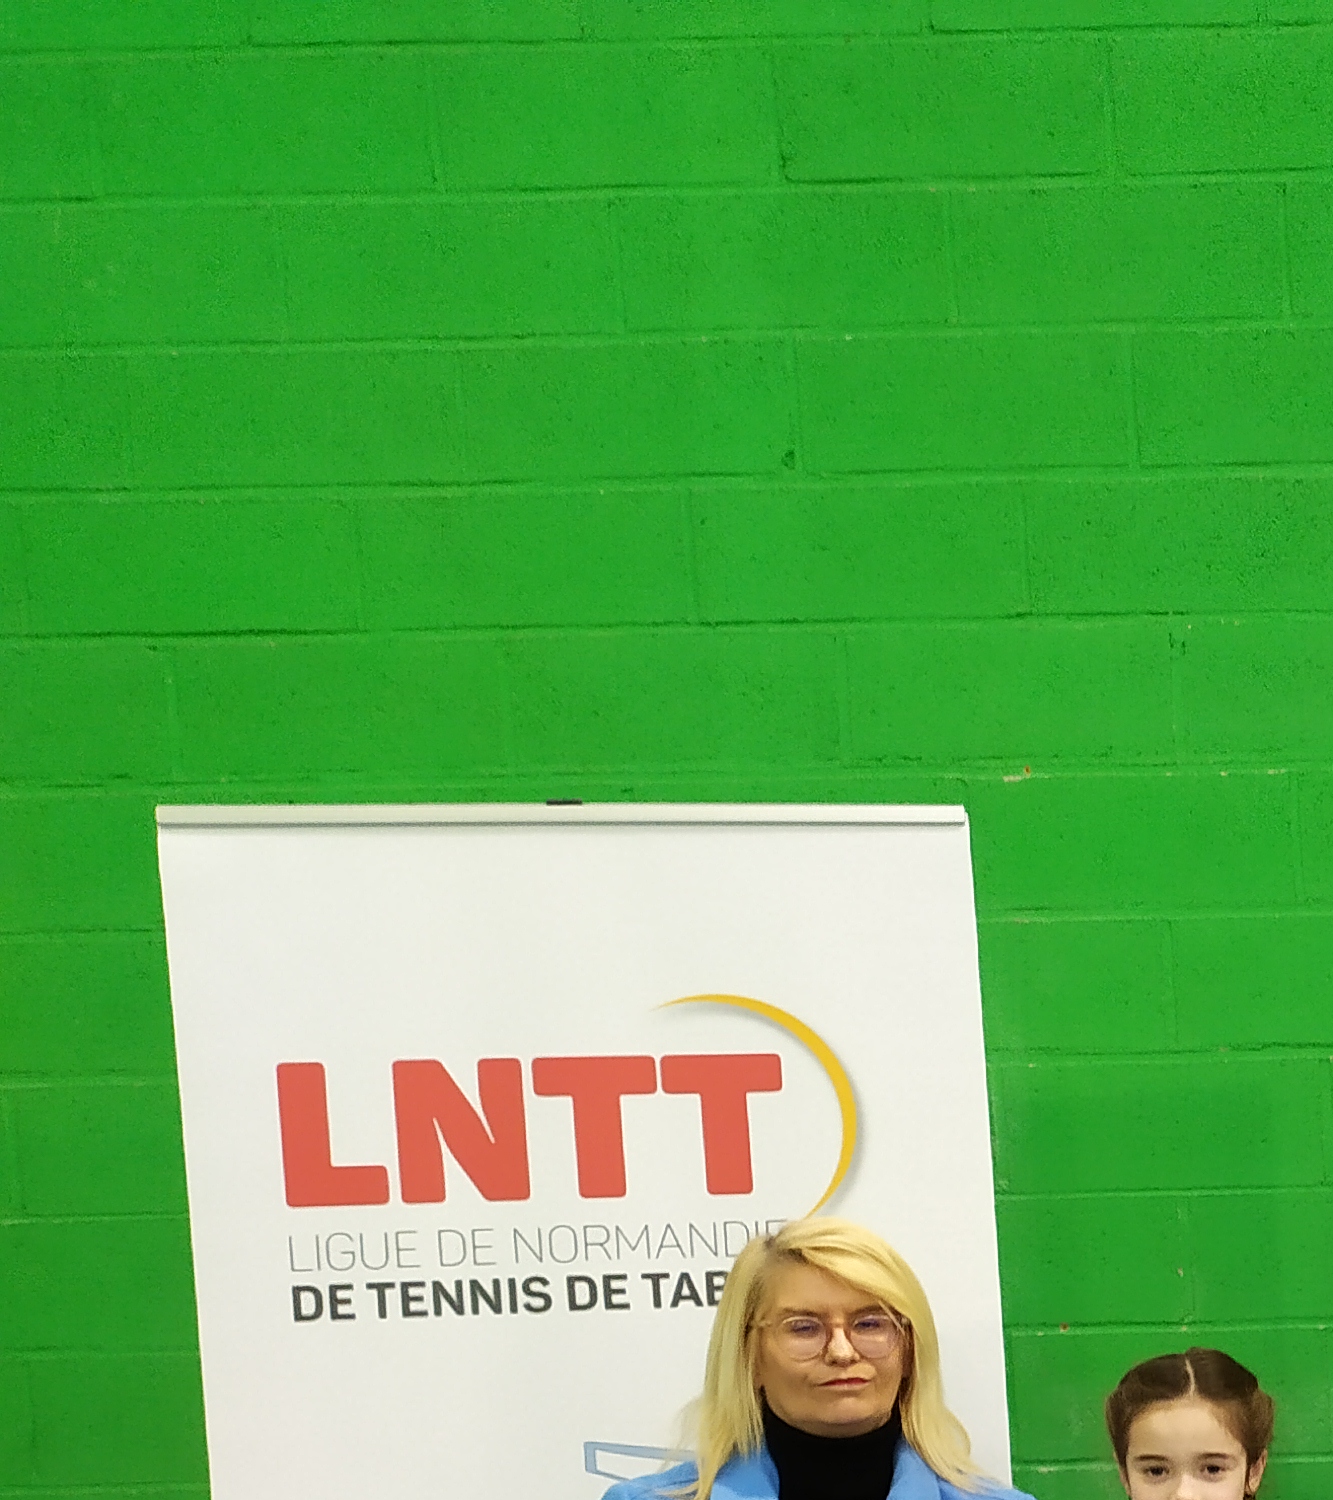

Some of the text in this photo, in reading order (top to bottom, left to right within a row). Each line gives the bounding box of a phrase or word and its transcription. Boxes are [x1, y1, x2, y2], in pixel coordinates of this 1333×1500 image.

[276, 1053, 782, 1207] LNTT
[289, 1229, 422, 1273] LIGUE
[437, 1227, 496, 1267] DE
[292, 1270, 728, 1322] DE TENNIS DE TAB
